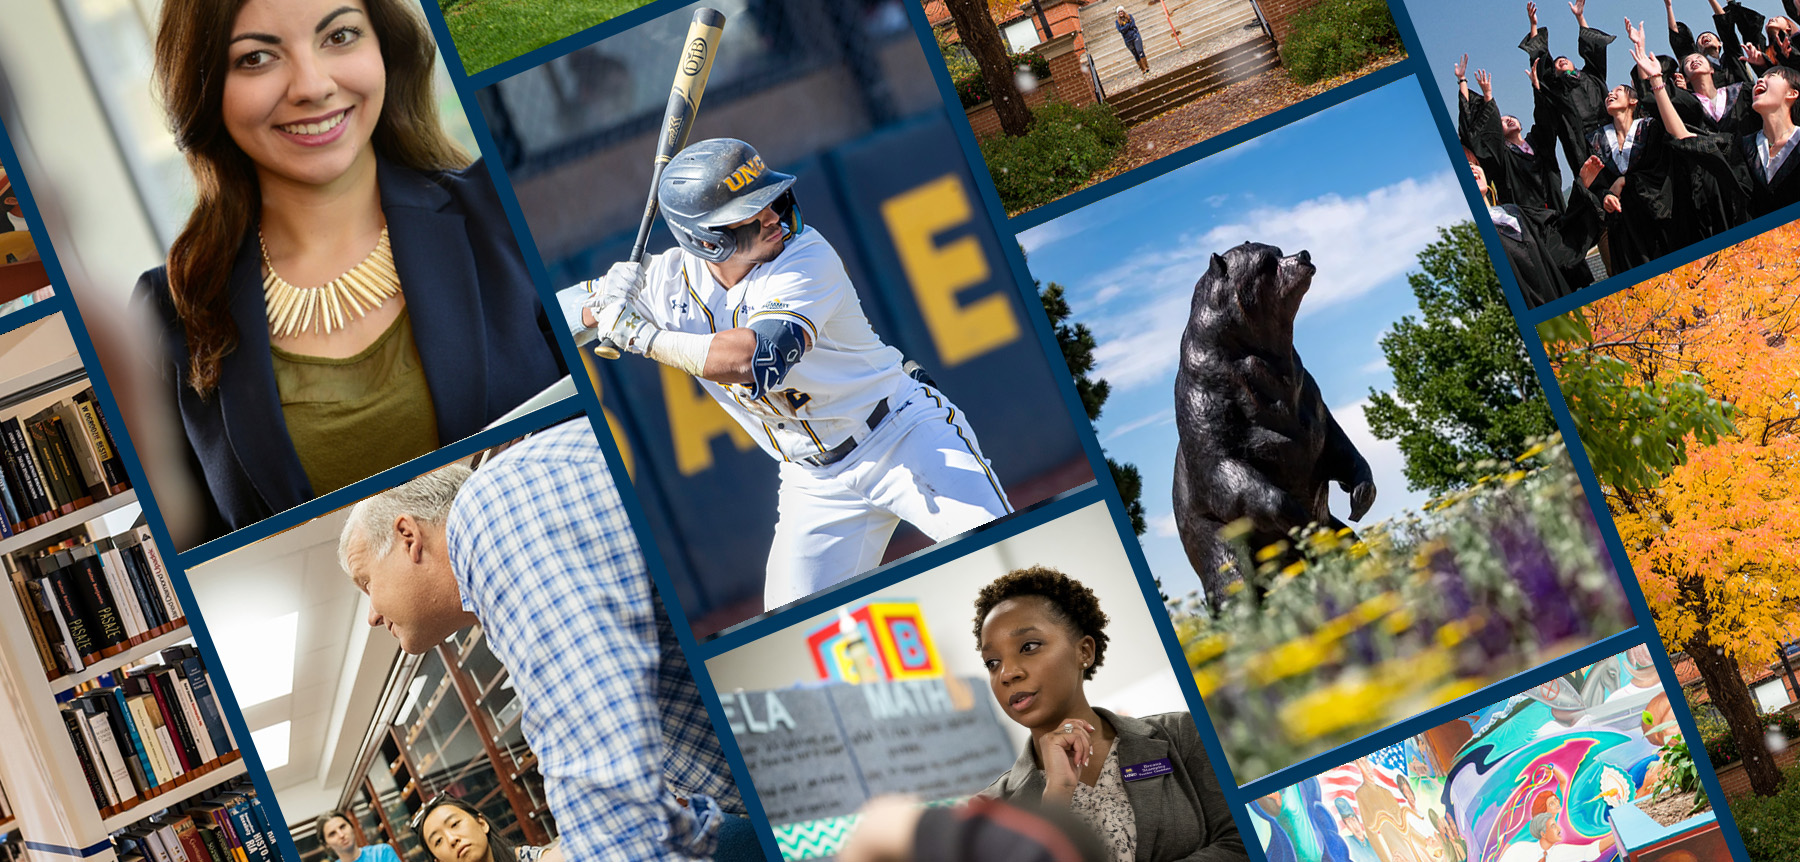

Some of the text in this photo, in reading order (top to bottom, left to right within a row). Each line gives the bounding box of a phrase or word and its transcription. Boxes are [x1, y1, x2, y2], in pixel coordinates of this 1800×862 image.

[723, 155, 765, 192] UNC
[146, 547, 162, 574] Upadek
[91, 582, 104, 605] Benjamin
[155, 572, 173, 602] Diamond
[67, 617, 93, 650] PASAŻE
[97, 605, 122, 638] PASAŻE
